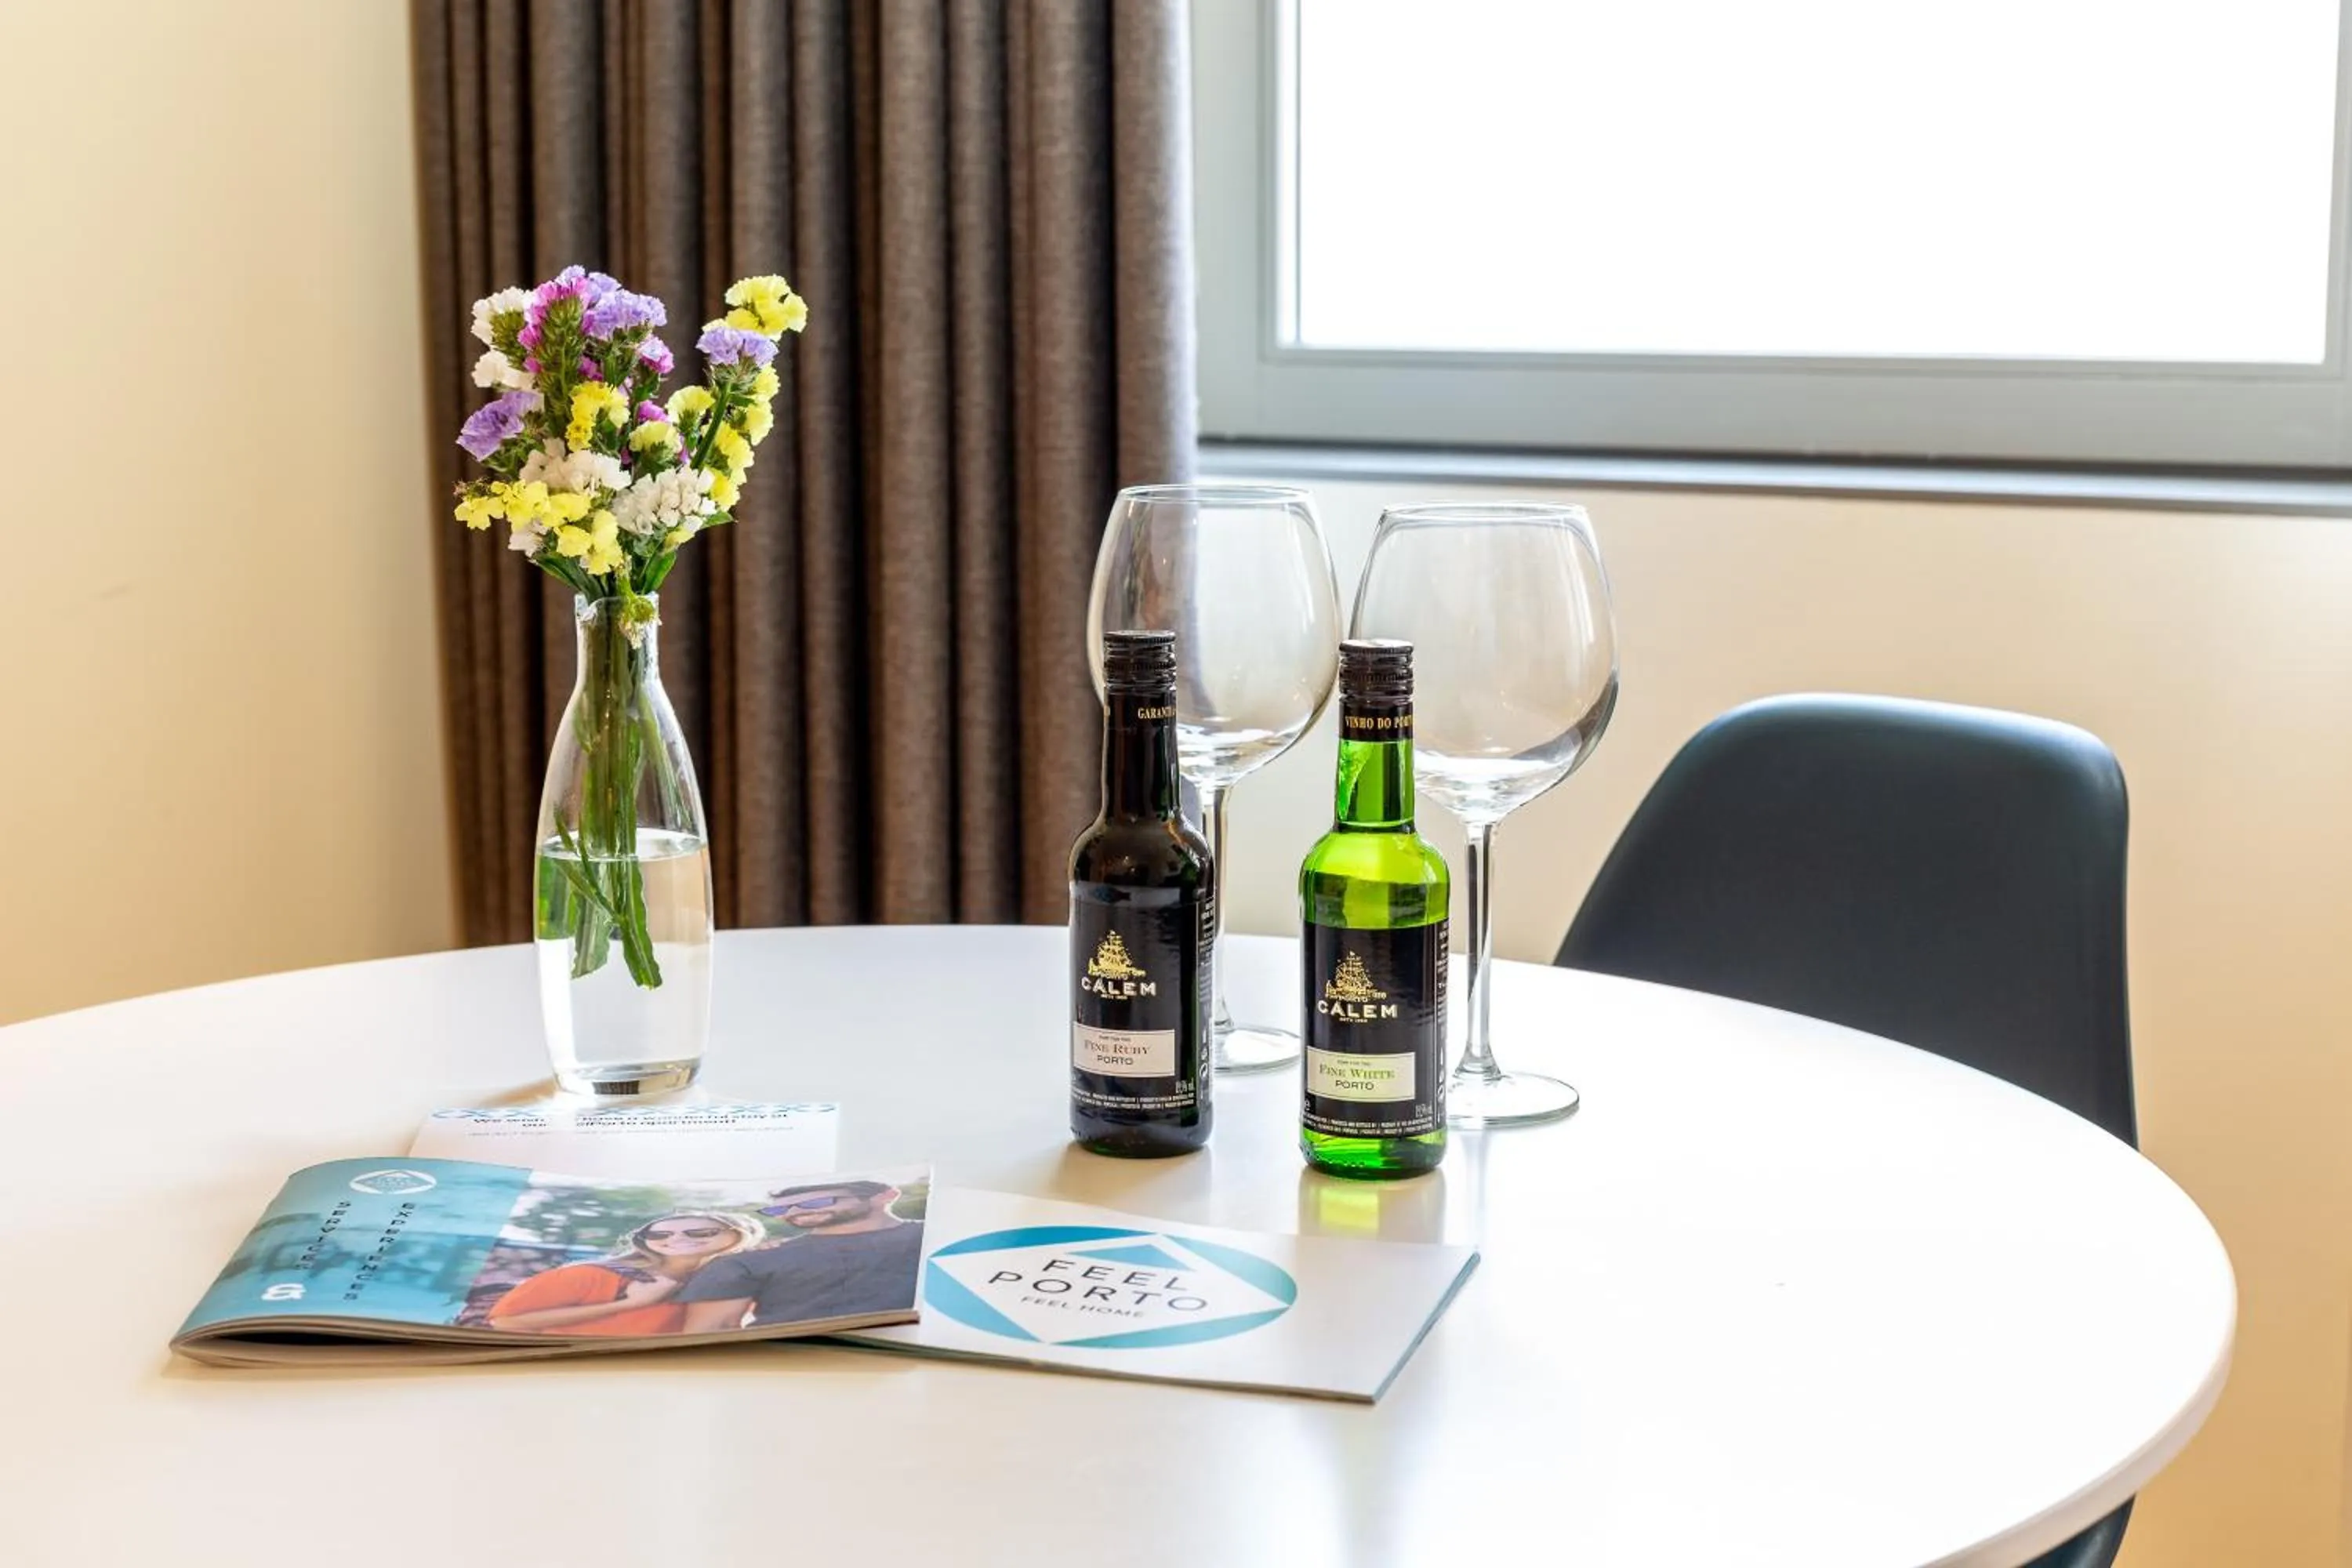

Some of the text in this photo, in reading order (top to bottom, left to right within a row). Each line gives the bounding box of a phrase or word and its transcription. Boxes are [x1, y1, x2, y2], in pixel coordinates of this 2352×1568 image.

[1345, 715, 1374, 729] VINHO
[1377, 717, 1392, 729] DO
[1084, 1039, 1152, 1054] FINE RUBY
[1097, 1054, 1134, 1065] PORTO
[1319, 1062, 1346, 1077] FINE
[1349, 1068, 1396, 1080] WHITE
[1334, 1080, 1374, 1091] PORTO
[1042, 1258, 1188, 1291] FEEL
[988, 1270, 1207, 1311] PORTO
[1021, 1296, 1145, 1318] FEEL HOME
